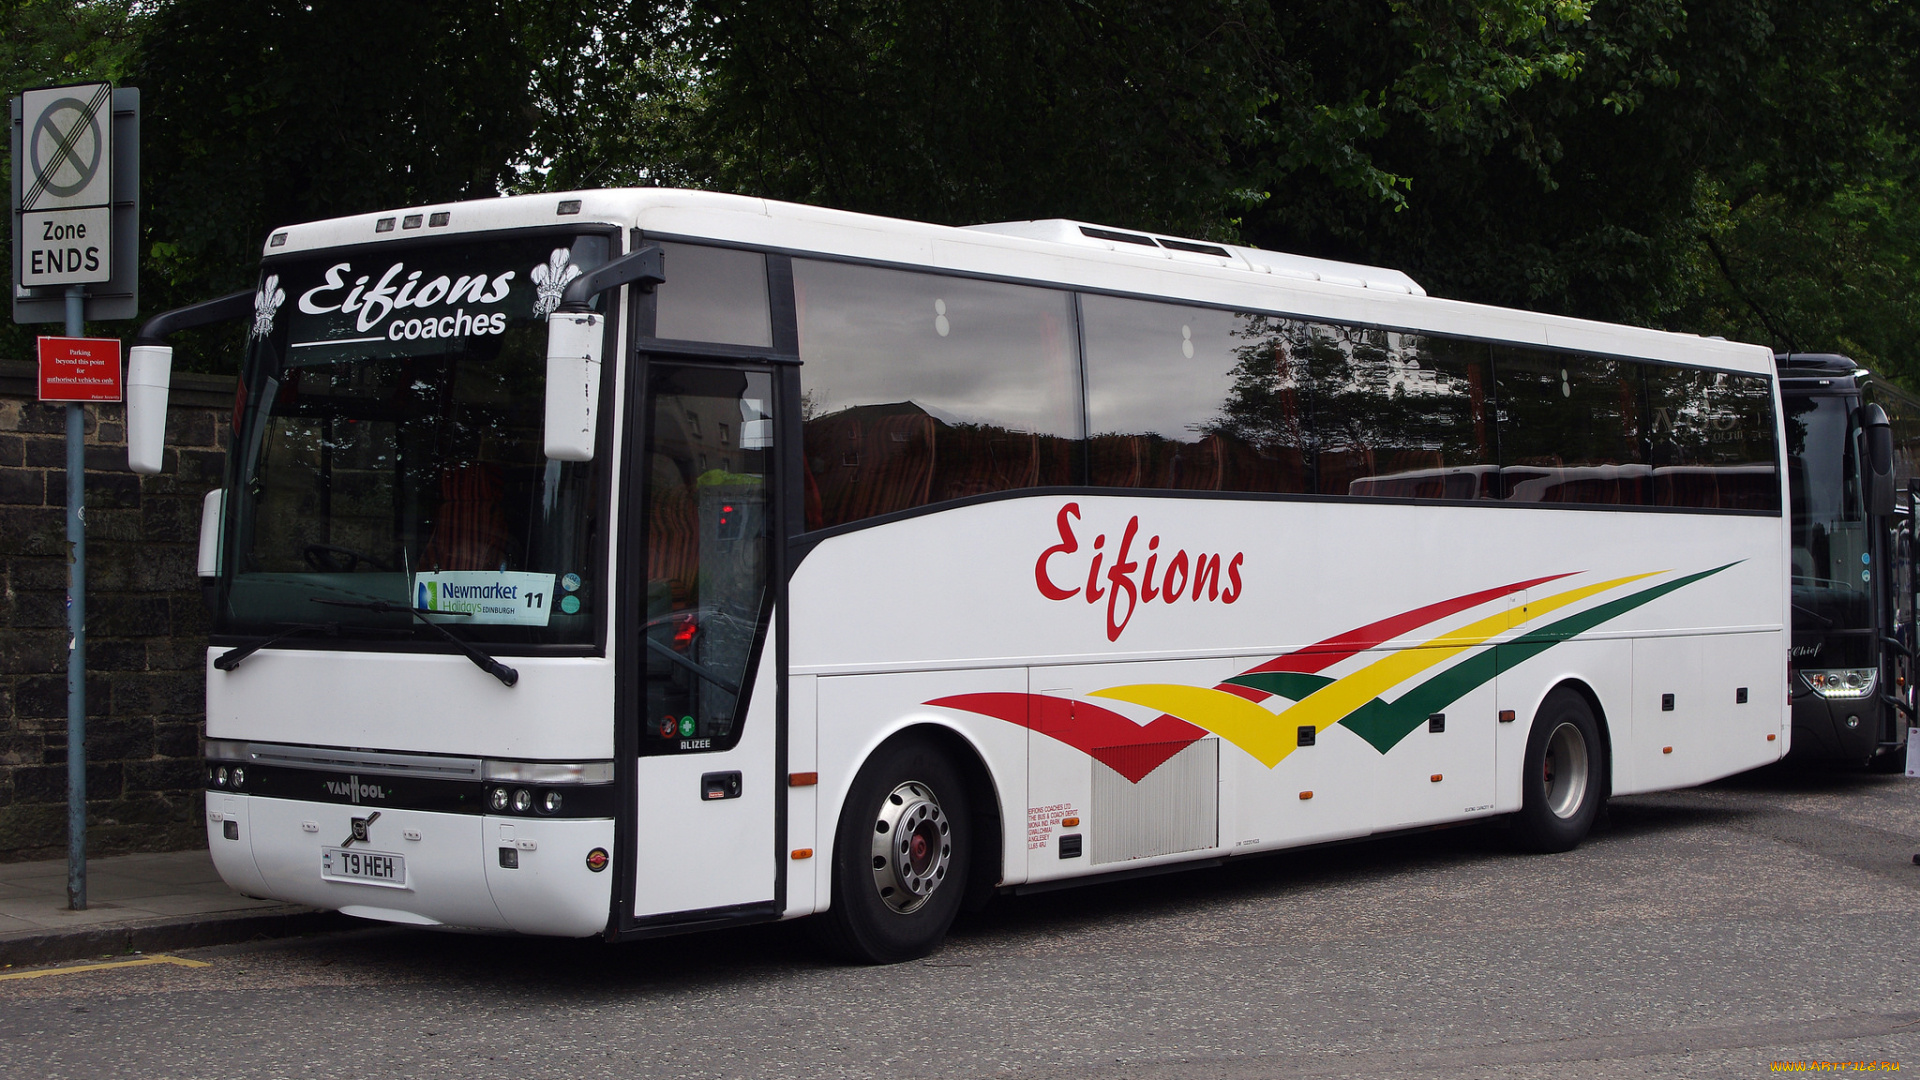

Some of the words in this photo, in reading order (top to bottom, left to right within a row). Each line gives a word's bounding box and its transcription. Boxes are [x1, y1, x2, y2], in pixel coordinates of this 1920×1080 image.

[43, 221, 86, 241] Zone
[31, 246, 100, 275] ENDS
[298, 262, 516, 333] Eifions
[388, 308, 507, 341] coaches
[1035, 502, 1244, 642] Eifions
[442, 582, 517, 600] Newmarket
[524, 592, 544, 609] 11
[442, 600, 482, 615] Holidays
[482, 606, 515, 615] EDINBURGH
[1791, 642, 1822, 658] Chief
[680, 739, 711, 750] ALIZEE
[1044, 804, 1063, 812] COACHES
[341, 852, 360, 875] T9
[363, 855, 393, 878] HEH
